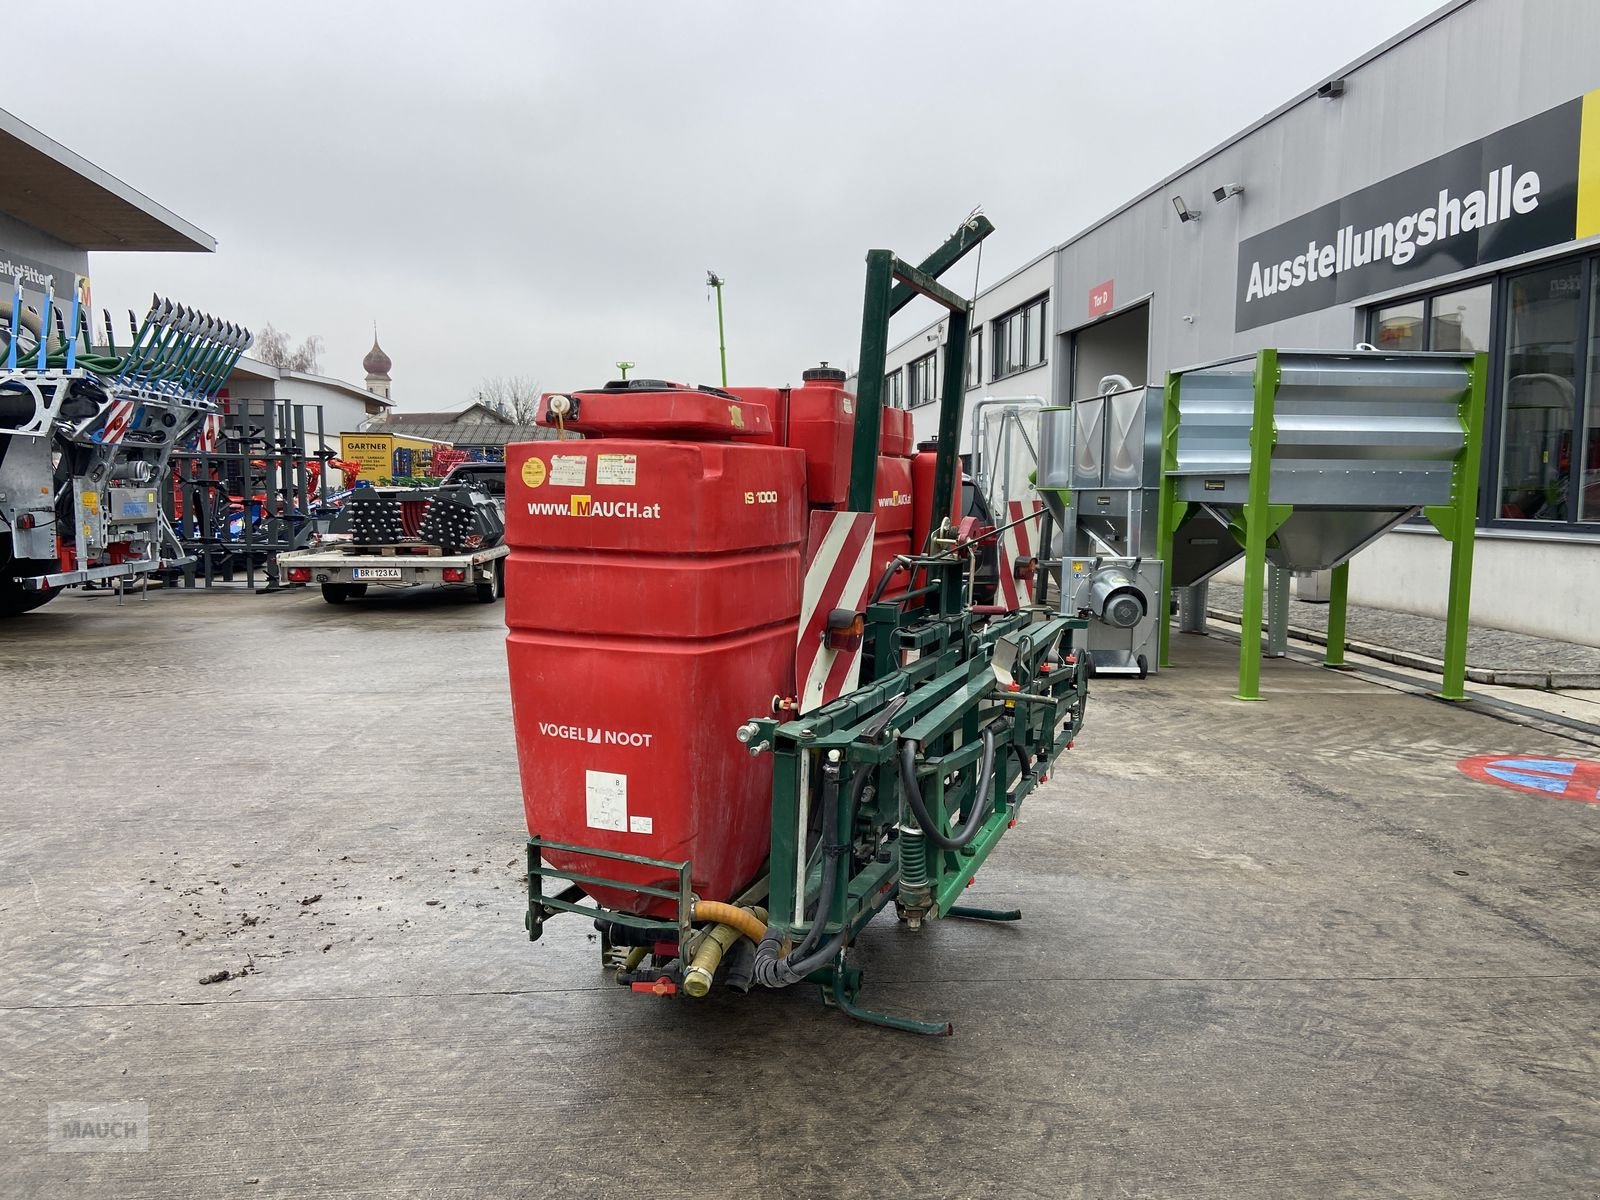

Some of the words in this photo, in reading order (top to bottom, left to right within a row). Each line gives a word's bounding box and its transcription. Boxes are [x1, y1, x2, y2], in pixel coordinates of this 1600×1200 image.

[1245, 164, 1541, 303] Ausstellungshalle
[0, 260, 53, 286] erkstätte
[1094, 295, 1102, 308] Tor
[1103, 291, 1108, 304] D
[744, 491, 755, 504] IS
[756, 490, 778, 504] 1000
[527, 501, 661, 519] www.MAUCH.at
[360, 569, 370, 577] BR
[538, 721, 587, 742] VOGEL
[604, 730, 653, 748] NOOT
